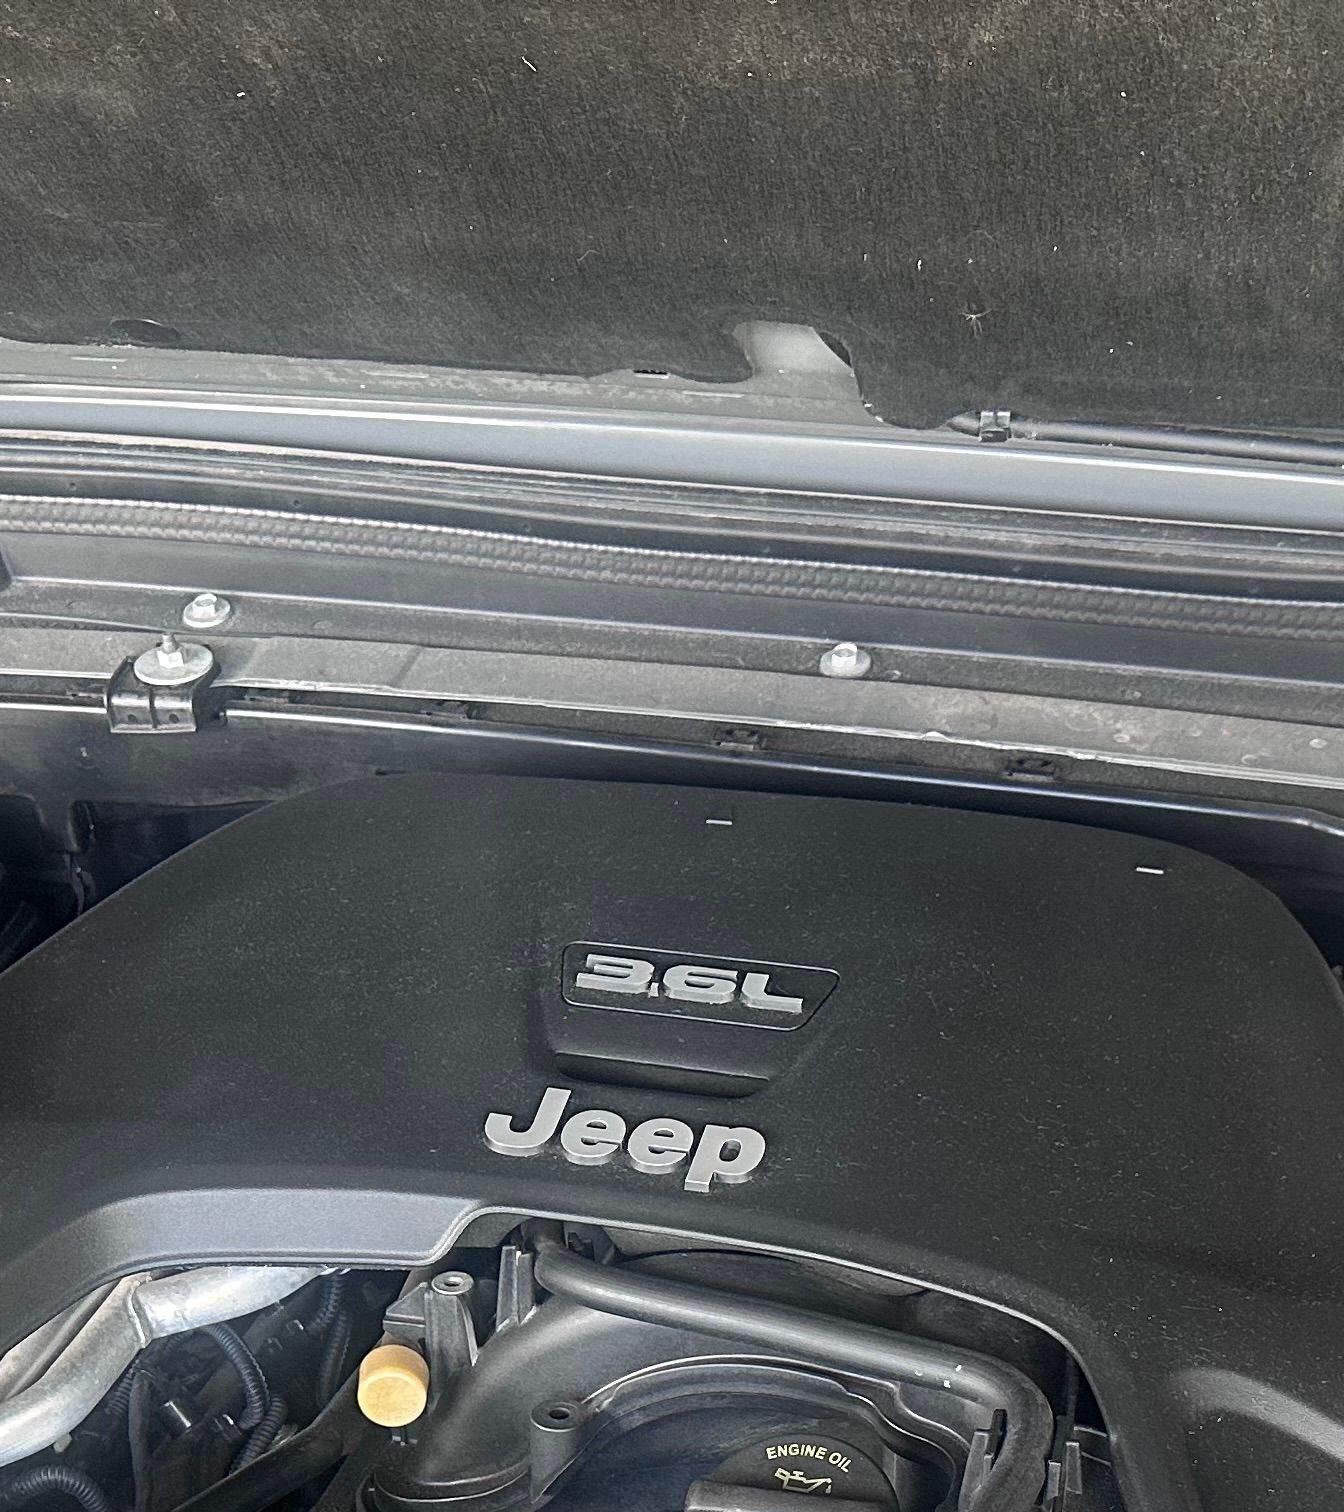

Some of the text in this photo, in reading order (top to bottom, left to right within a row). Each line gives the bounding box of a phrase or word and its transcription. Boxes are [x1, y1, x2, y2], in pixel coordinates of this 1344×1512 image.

[575, 953, 805, 1015] 3.6L
[483, 1086, 767, 1193] Jeep
[766, 1443, 853, 1473] ENGINE OIL
